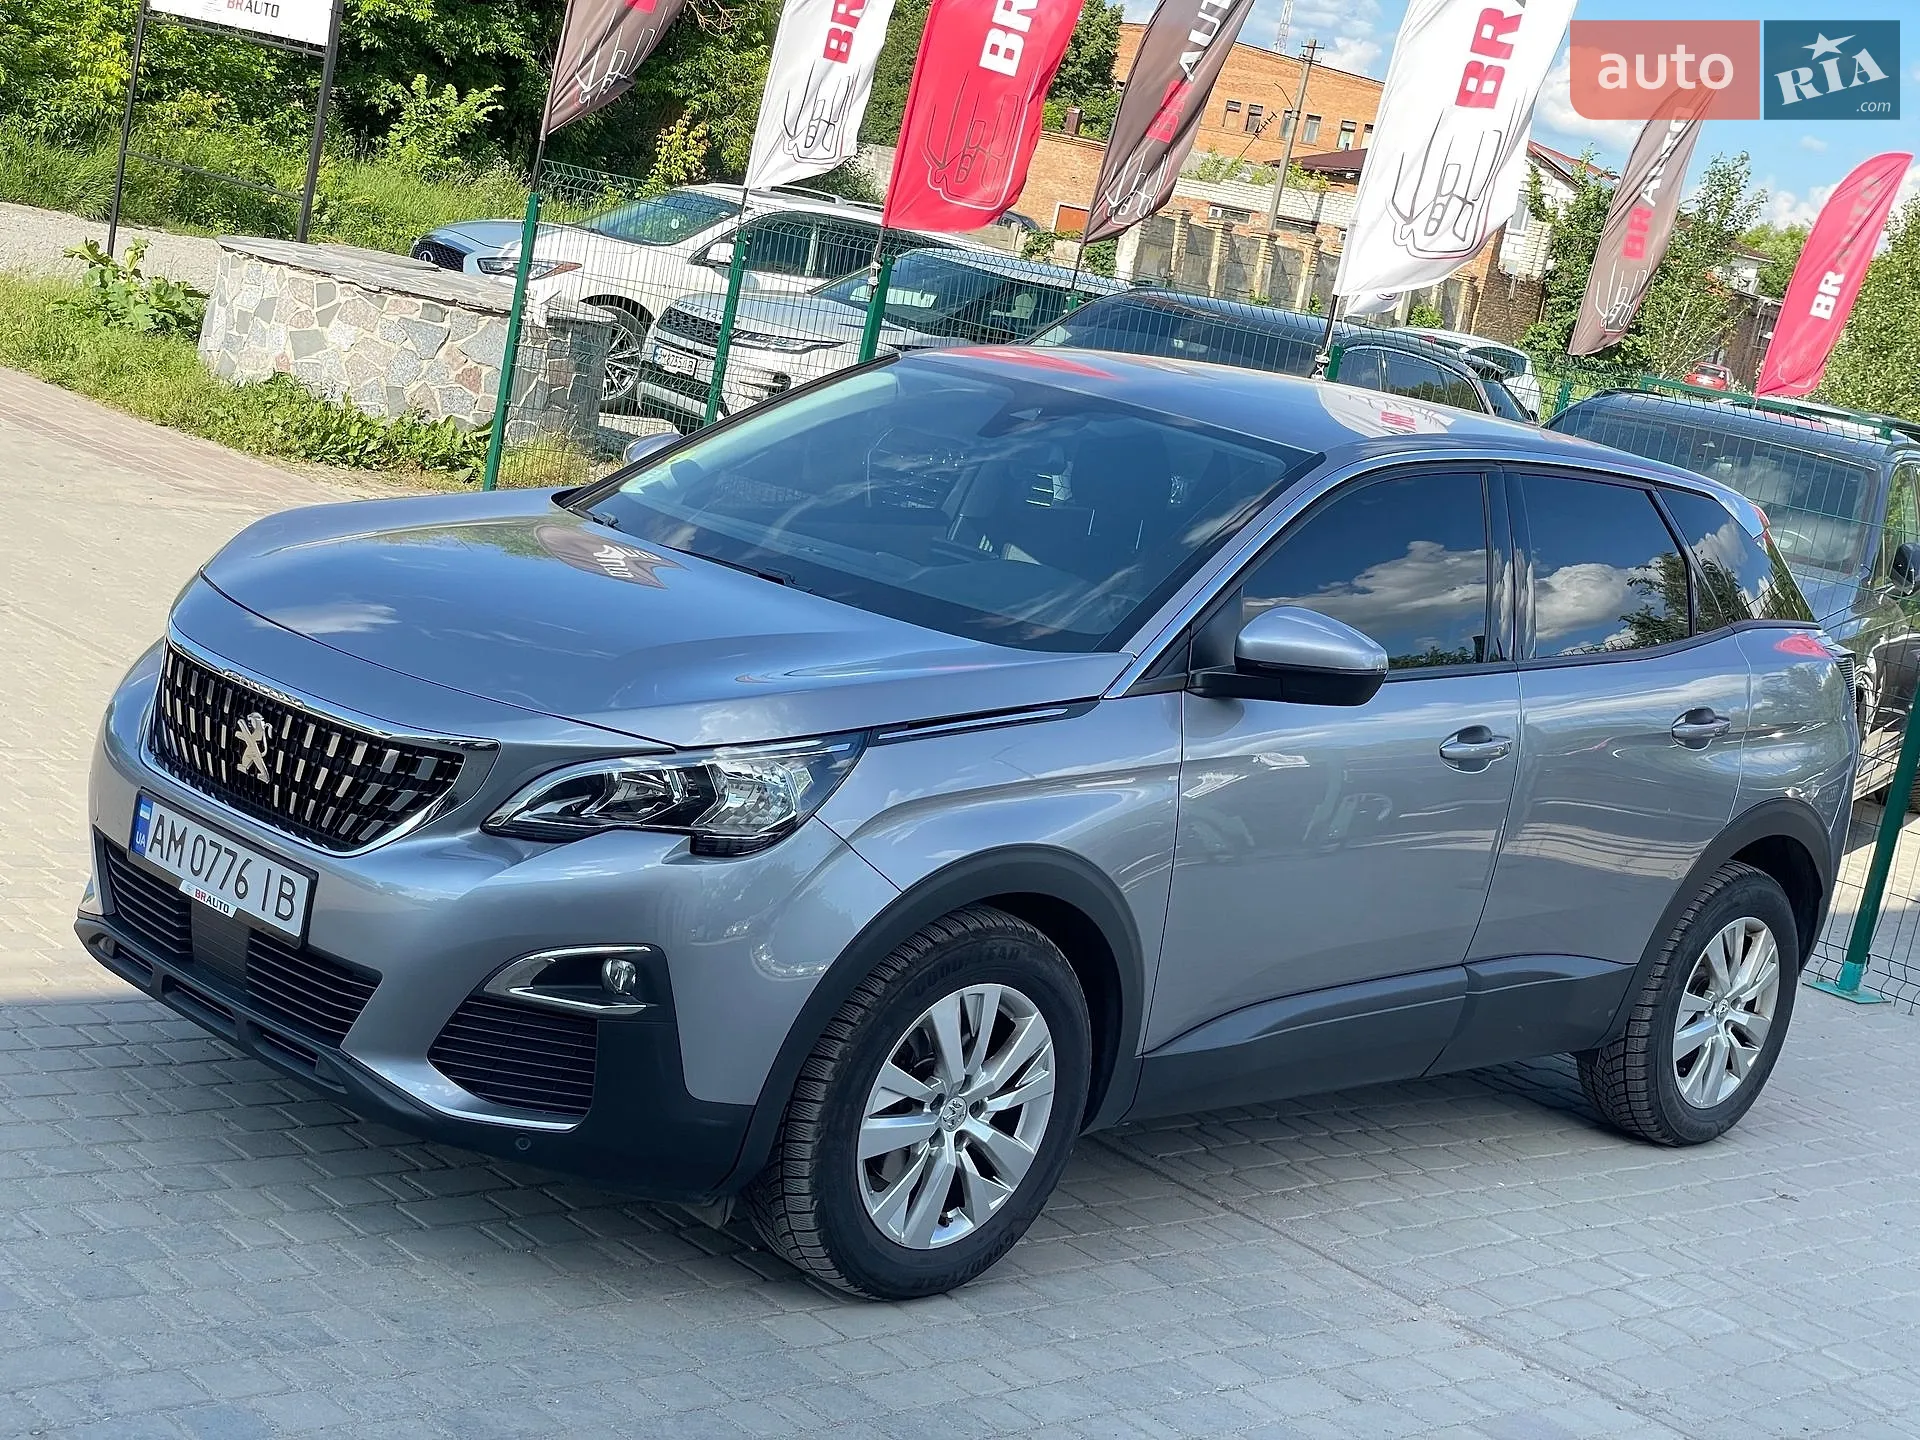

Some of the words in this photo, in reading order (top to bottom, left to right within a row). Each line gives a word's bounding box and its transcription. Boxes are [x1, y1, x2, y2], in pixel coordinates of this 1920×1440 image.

[226, 0, 280, 18] BRAUTO
[1455, 0, 1526, 109] BR
[136, 831, 146, 847] UA
[149, 813, 187, 868] AM
[190, 834, 252, 899] 0776
[261, 868, 296, 921] IB
[194, 889, 229, 914] BRAUTO
